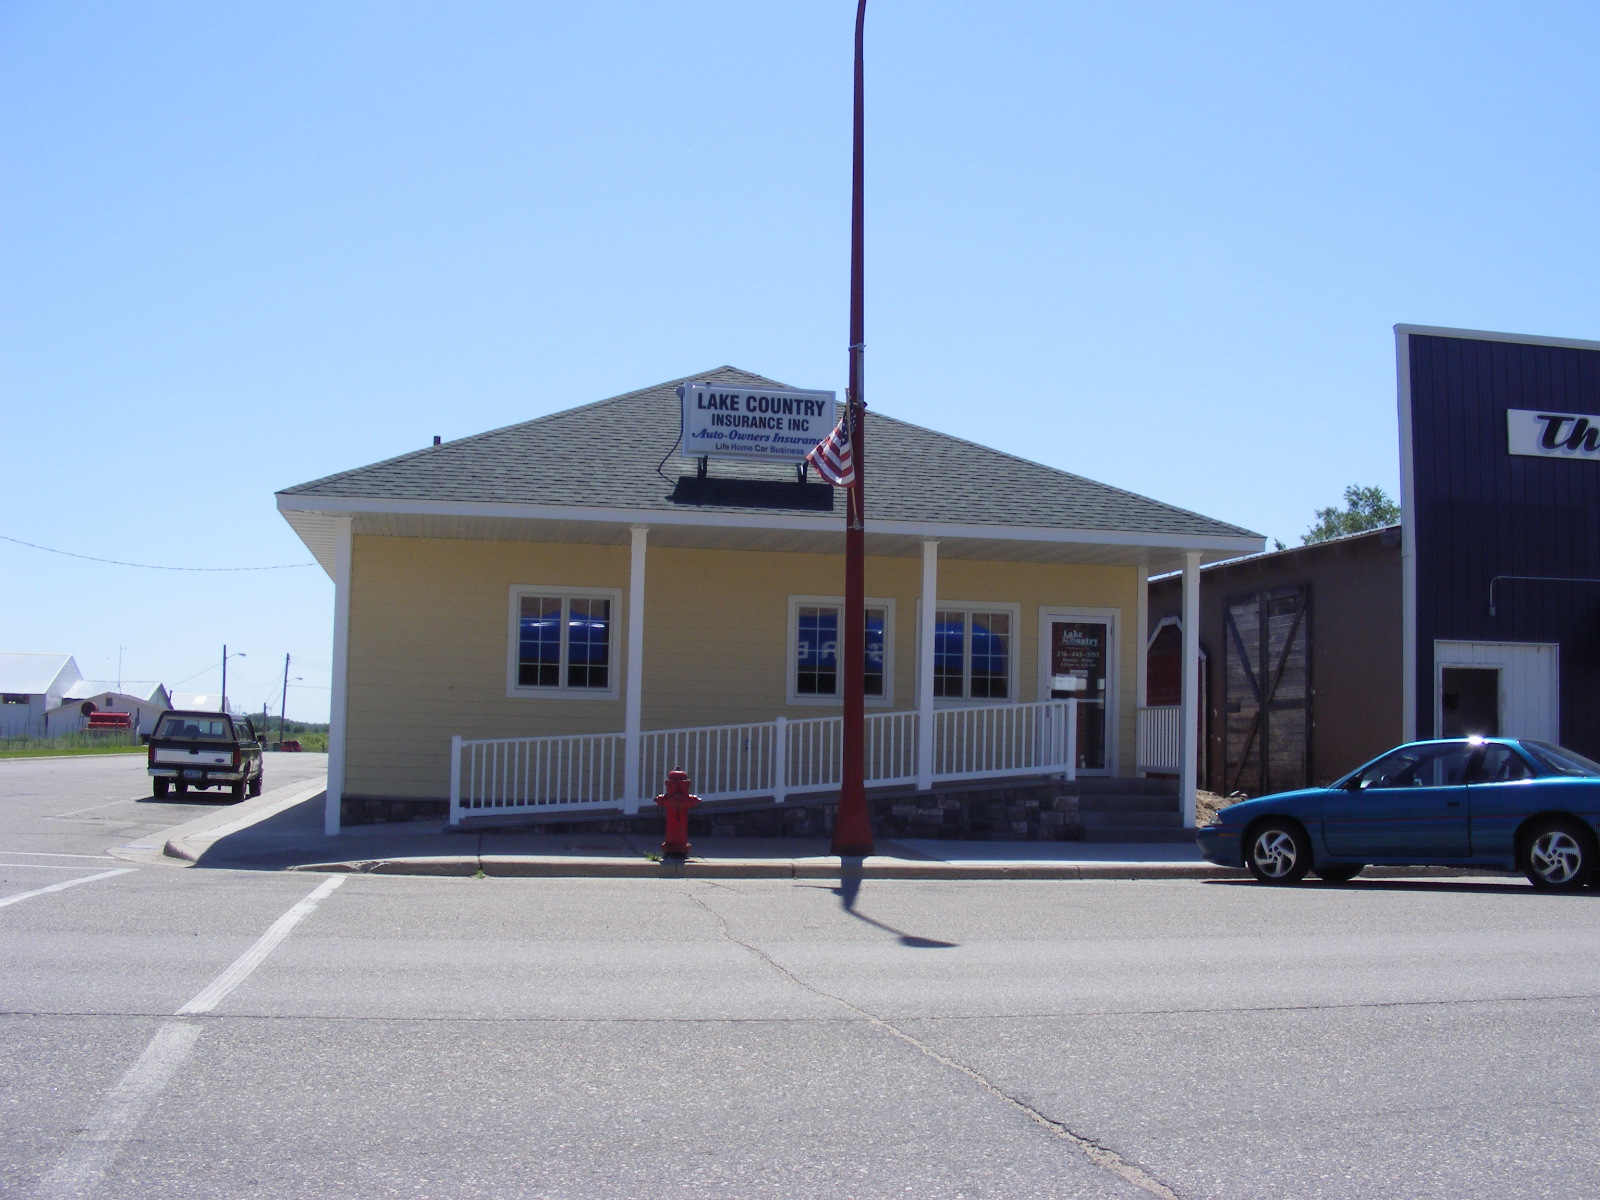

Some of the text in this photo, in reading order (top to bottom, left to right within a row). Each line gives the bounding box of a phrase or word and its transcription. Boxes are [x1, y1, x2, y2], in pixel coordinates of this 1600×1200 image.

[698, 392, 825, 416] LAKE COUNTRY
[712, 414, 810, 432] INSURANCE INC
[692, 428, 823, 446] Auto-Owners Insuranc
[730, 443, 753, 452] Home
[754, 444, 768, 453] Car
[770, 446, 804, 455] Business
